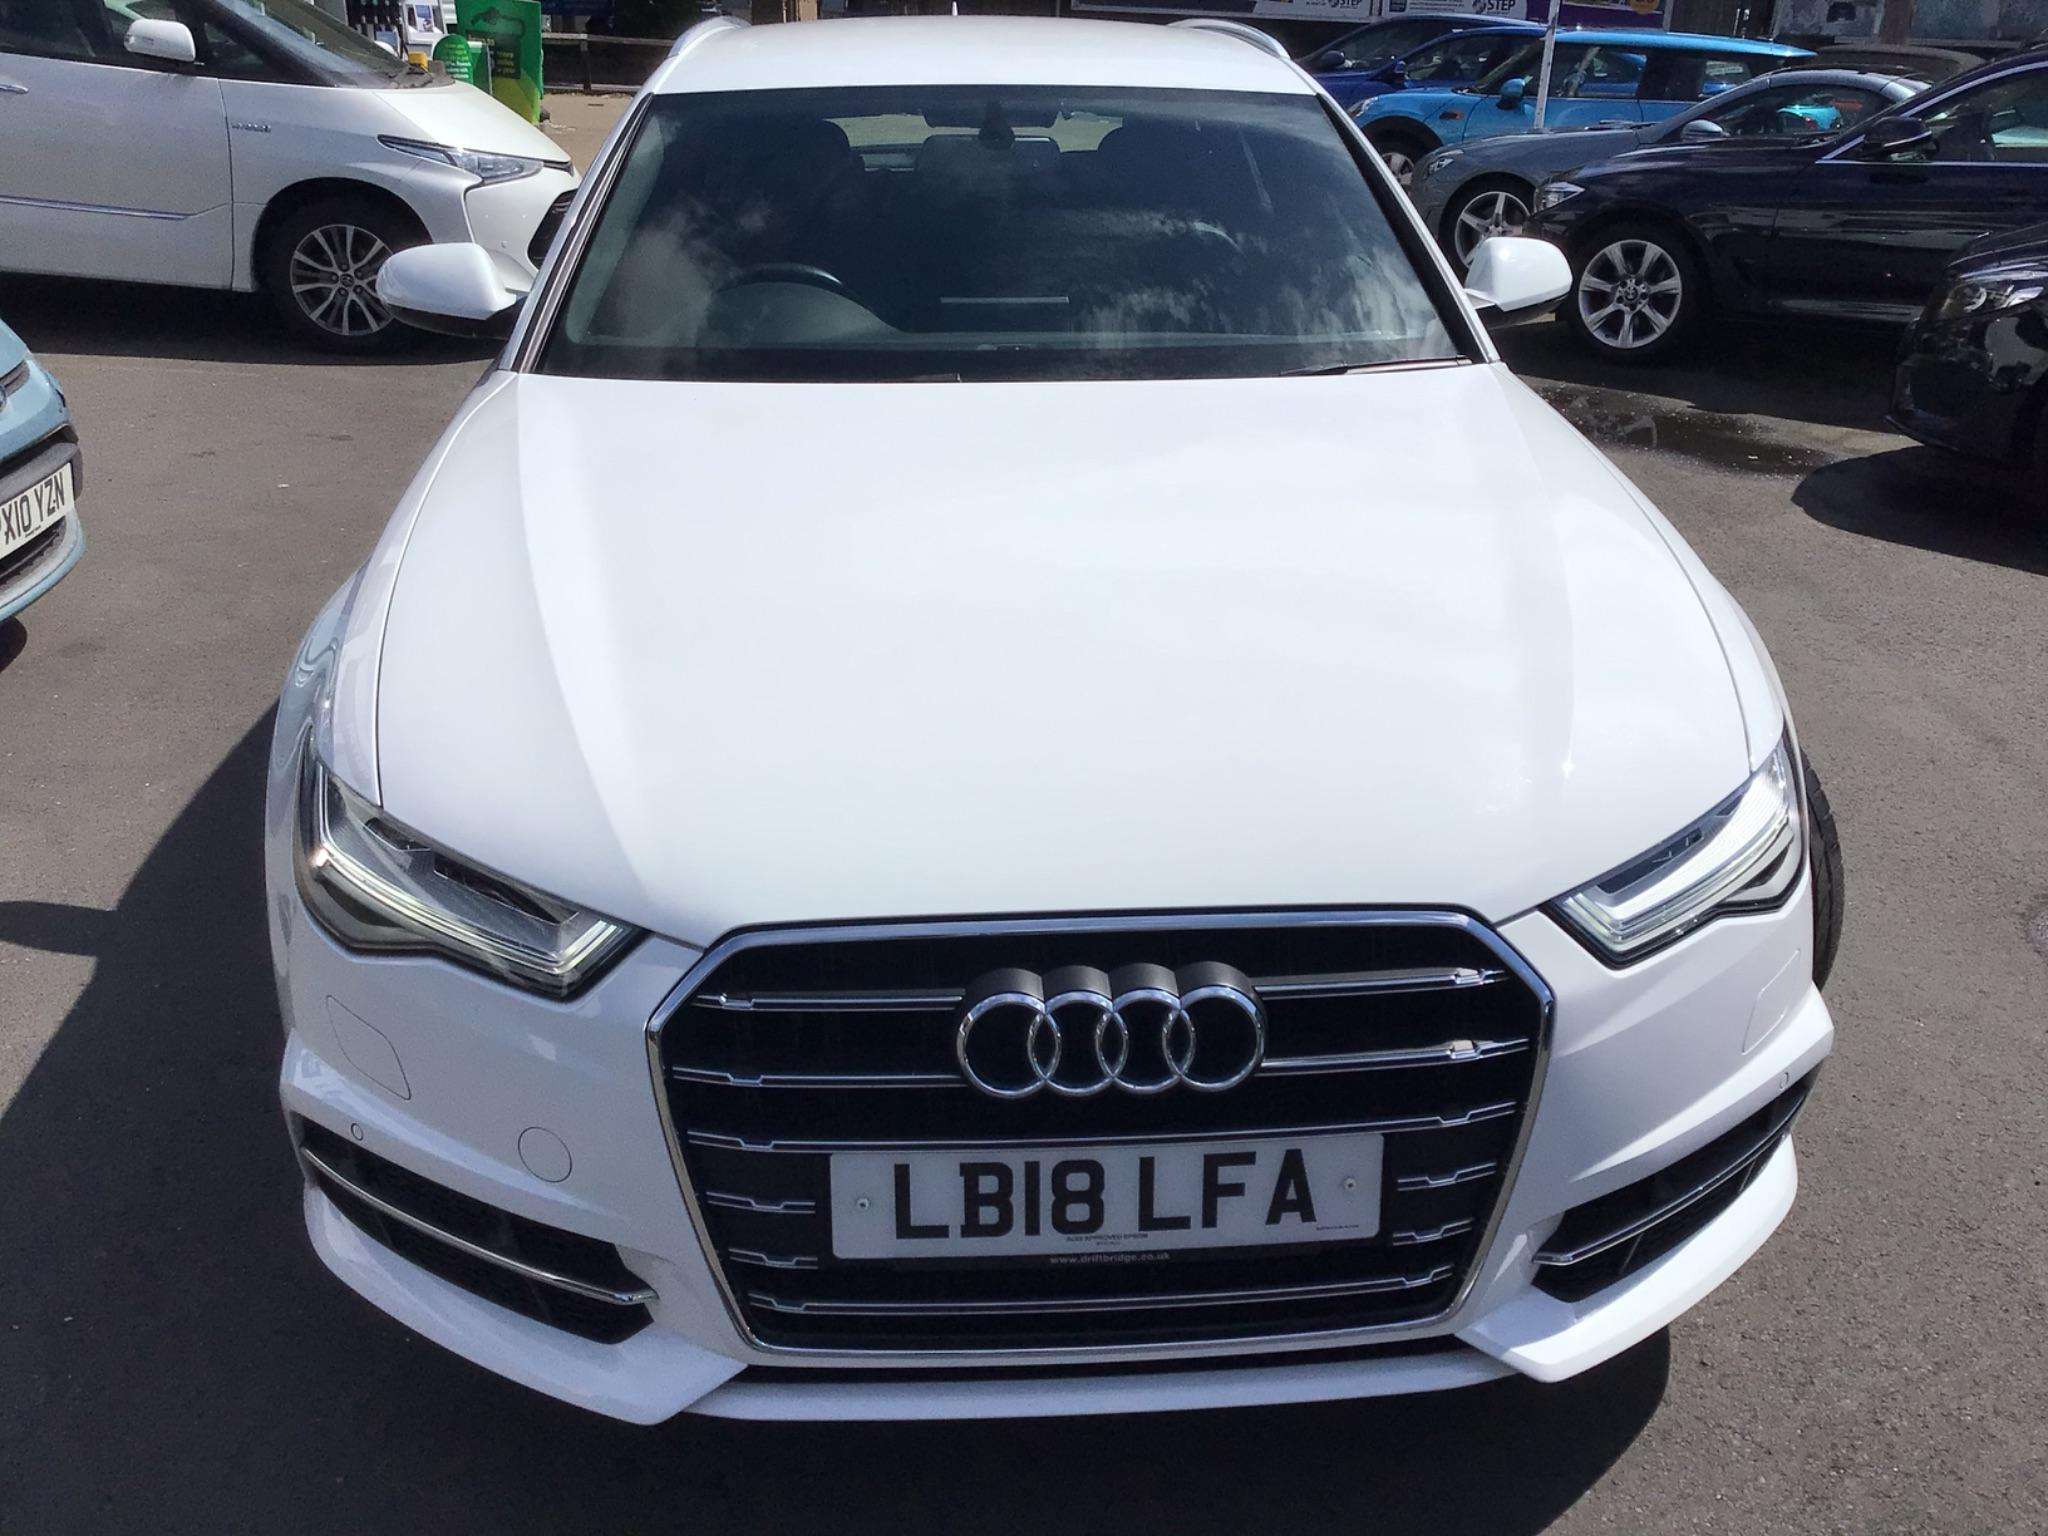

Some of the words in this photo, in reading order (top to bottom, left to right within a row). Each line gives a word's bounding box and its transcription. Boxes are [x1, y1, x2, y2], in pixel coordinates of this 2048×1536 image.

[1486, 0, 1516, 11] STEP
[0, 495, 31, 544] X10
[34, 471, 65, 522] YZN
[894, 1158, 1106, 1240] LB18
[1138, 1147, 1318, 1231] LFA
